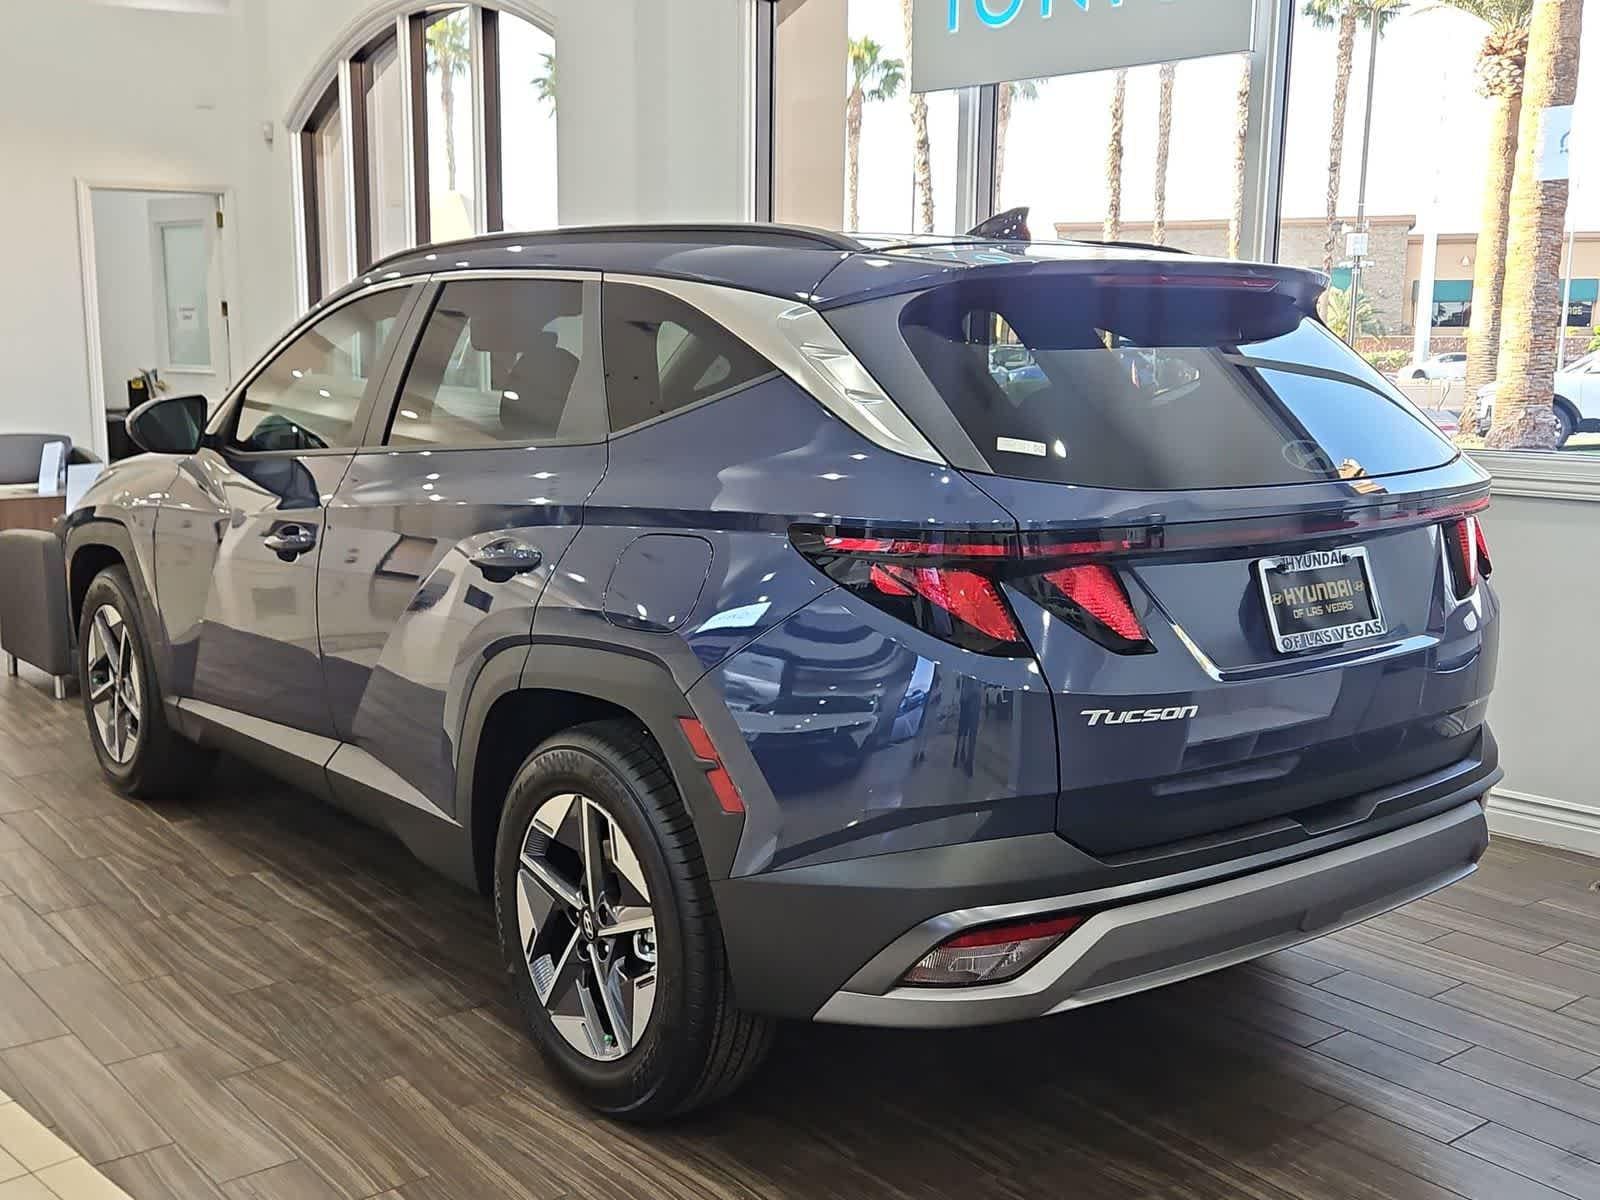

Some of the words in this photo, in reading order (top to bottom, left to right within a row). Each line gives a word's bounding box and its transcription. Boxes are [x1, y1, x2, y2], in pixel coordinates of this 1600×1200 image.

[1285, 551, 1342, 570] HYUNDAI
[1283, 579, 1354, 606] HYUNDAI
[1293, 608, 1304, 619] OF
[1306, 606, 1324, 617] LAS
[1326, 601, 1354, 614] VEGAS
[1282, 637, 1301, 650] OF
[1305, 630, 1332, 646] LAS
[1335, 621, 1382, 641] VEGAS
